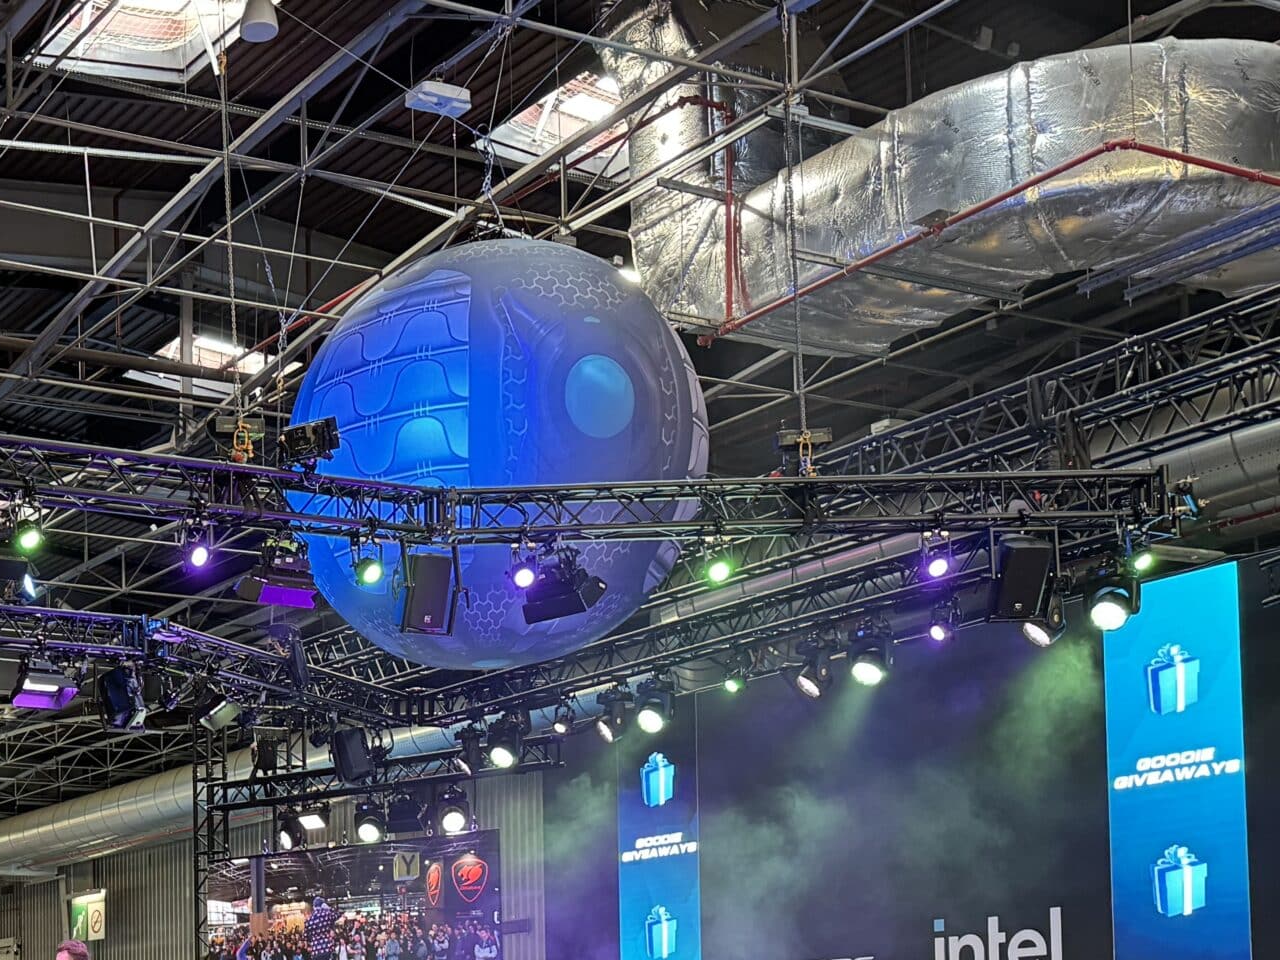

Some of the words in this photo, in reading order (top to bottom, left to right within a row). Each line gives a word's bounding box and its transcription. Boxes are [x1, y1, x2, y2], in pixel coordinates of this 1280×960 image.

[1136, 747, 1216, 771] GOODIE
[1113, 759, 1240, 790] GIVEAWAYS
[621, 841, 697, 862] GIVEAWAYS
